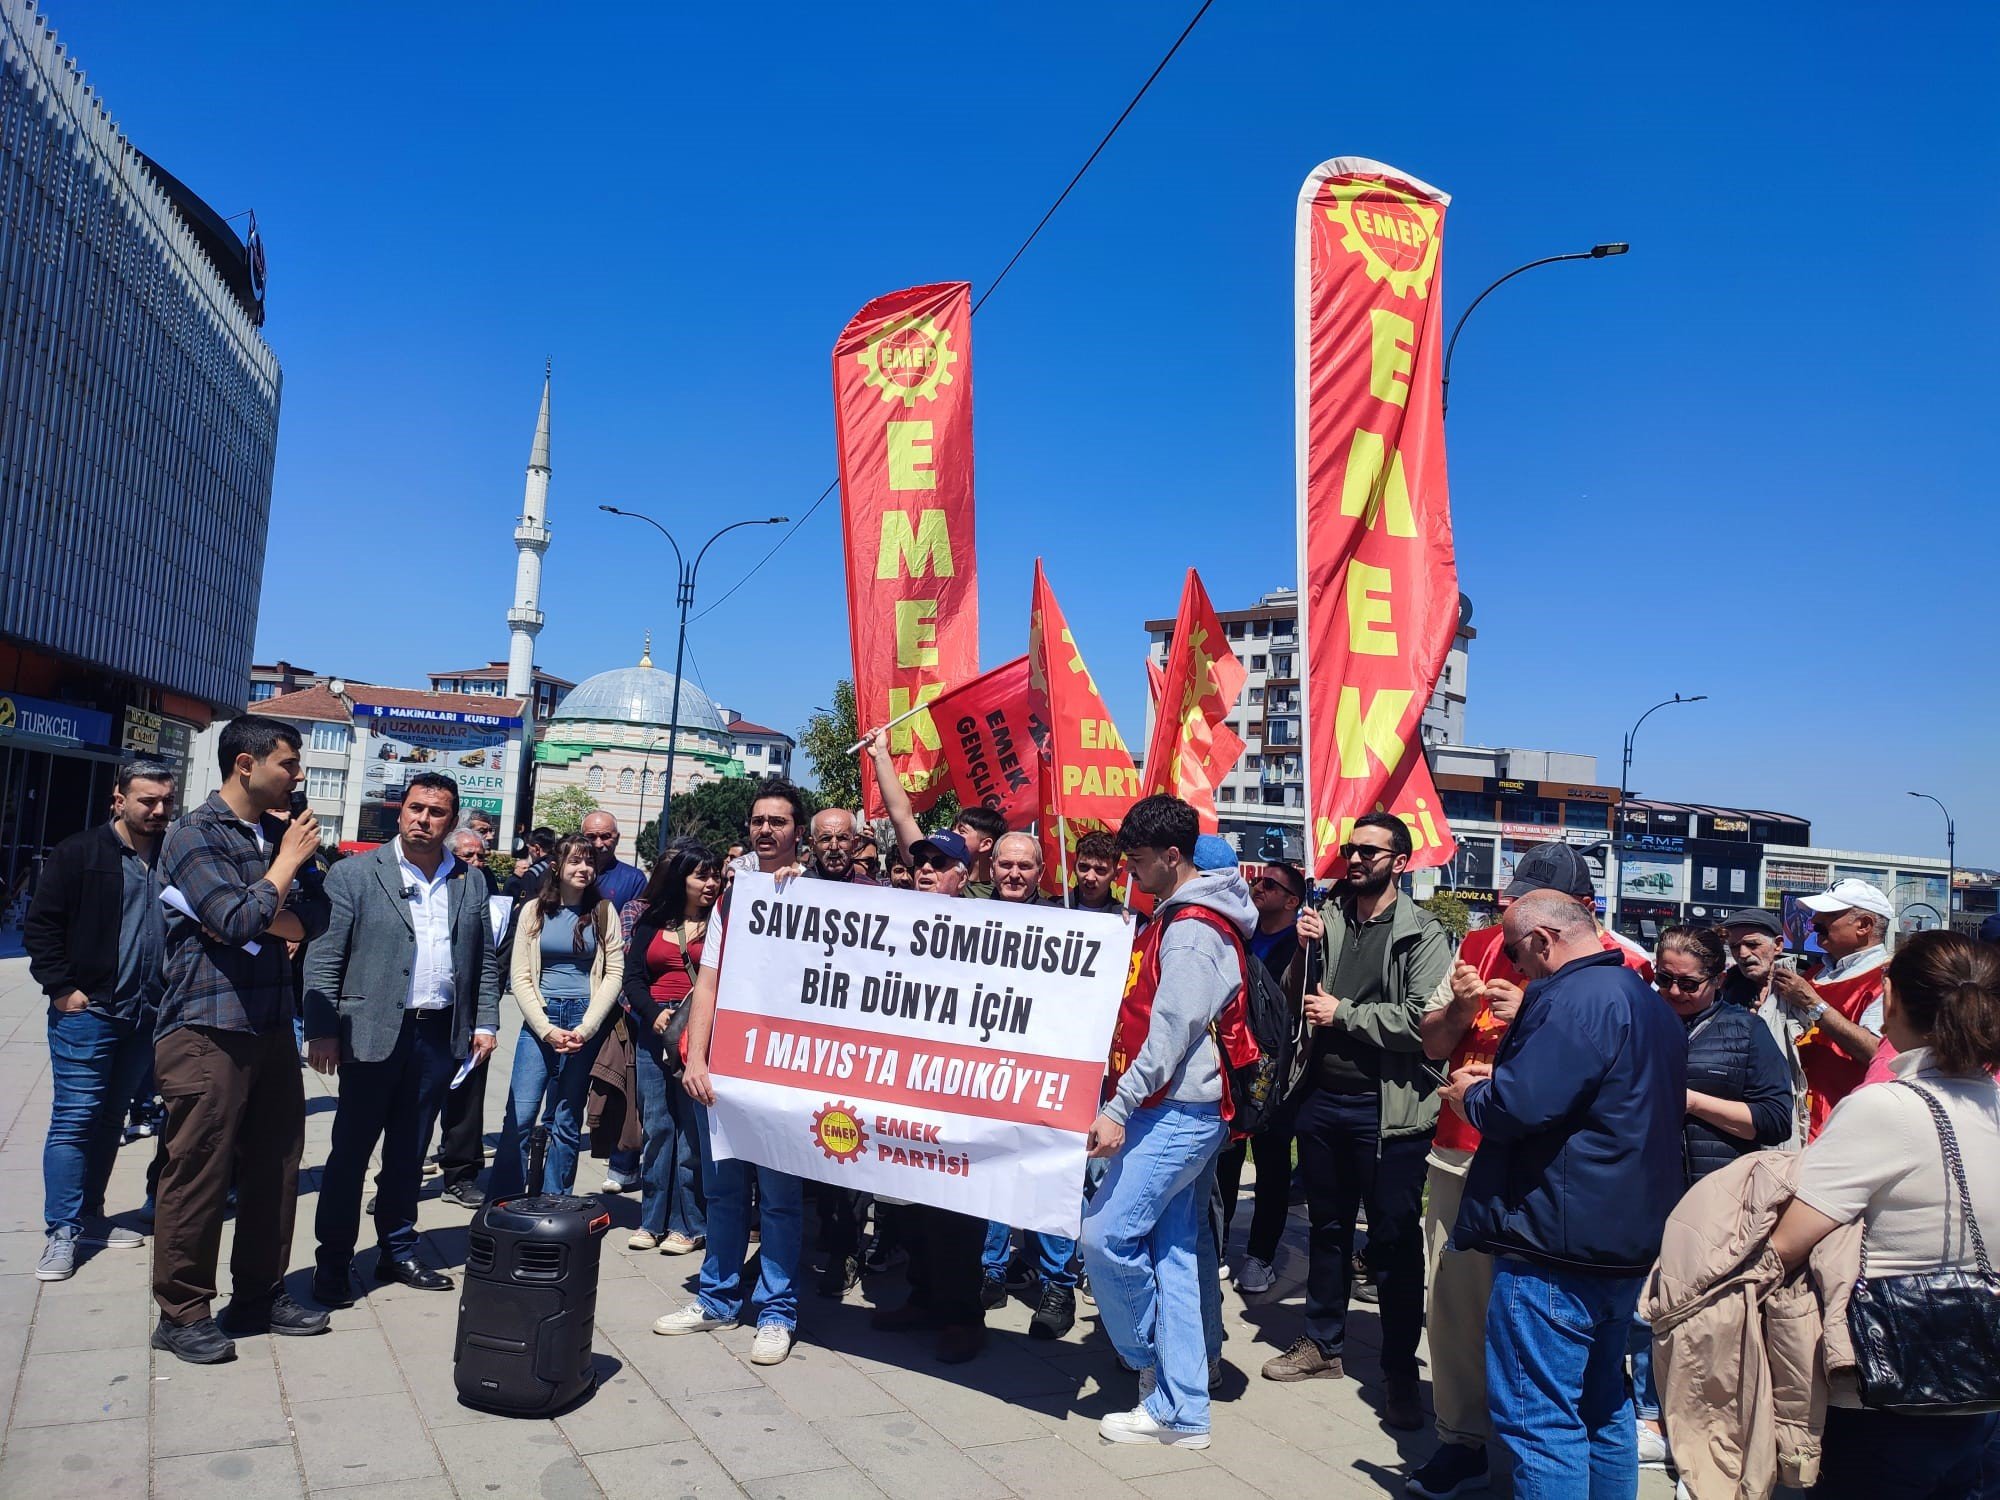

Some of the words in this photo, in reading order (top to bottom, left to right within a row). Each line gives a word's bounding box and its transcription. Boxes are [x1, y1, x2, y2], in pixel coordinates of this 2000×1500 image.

[1355, 209, 1426, 249] EMEP
[881, 346, 937, 368] EMEP
[21, 710, 80, 740] TURKCELL
[374, 706, 383, 717] İŞ
[389, 708, 456, 722] MAKİNALARI
[464, 715, 500, 725] KURSU
[389, 721, 468, 738] UZMANLAR
[1080, 718, 1127, 752] EM
[985, 710, 1031, 793] EMEK
[459, 775, 503, 788] SAFER
[1062, 765, 1138, 797] PART
[460, 799, 468, 807] 99
[471, 800, 483, 808] 08
[1513, 825, 1527, 833] TÜRK
[1641, 836, 1684, 846] RMF
[1456, 890, 1479, 900] DÖVİZ
[748, 899, 896, 957] SAVAŞSIZ,
[910, 914, 1101, 978] SÖMÜRÜSÜZ
[801, 963, 848, 1009] BİR
[861, 971, 958, 1025] DÜNYA
[969, 983, 1032, 1042] İÇİN
[744, 1028, 756, 1064] 1
[764, 1031, 897, 1086] MAYIS'TA
[906, 1053, 1070, 1112] KADIKÖY'E!
[823, 1124, 857, 1141] EMEP
[875, 1116, 942, 1145] EMEK
[877, 1143, 970, 1177] PARTİSİ
